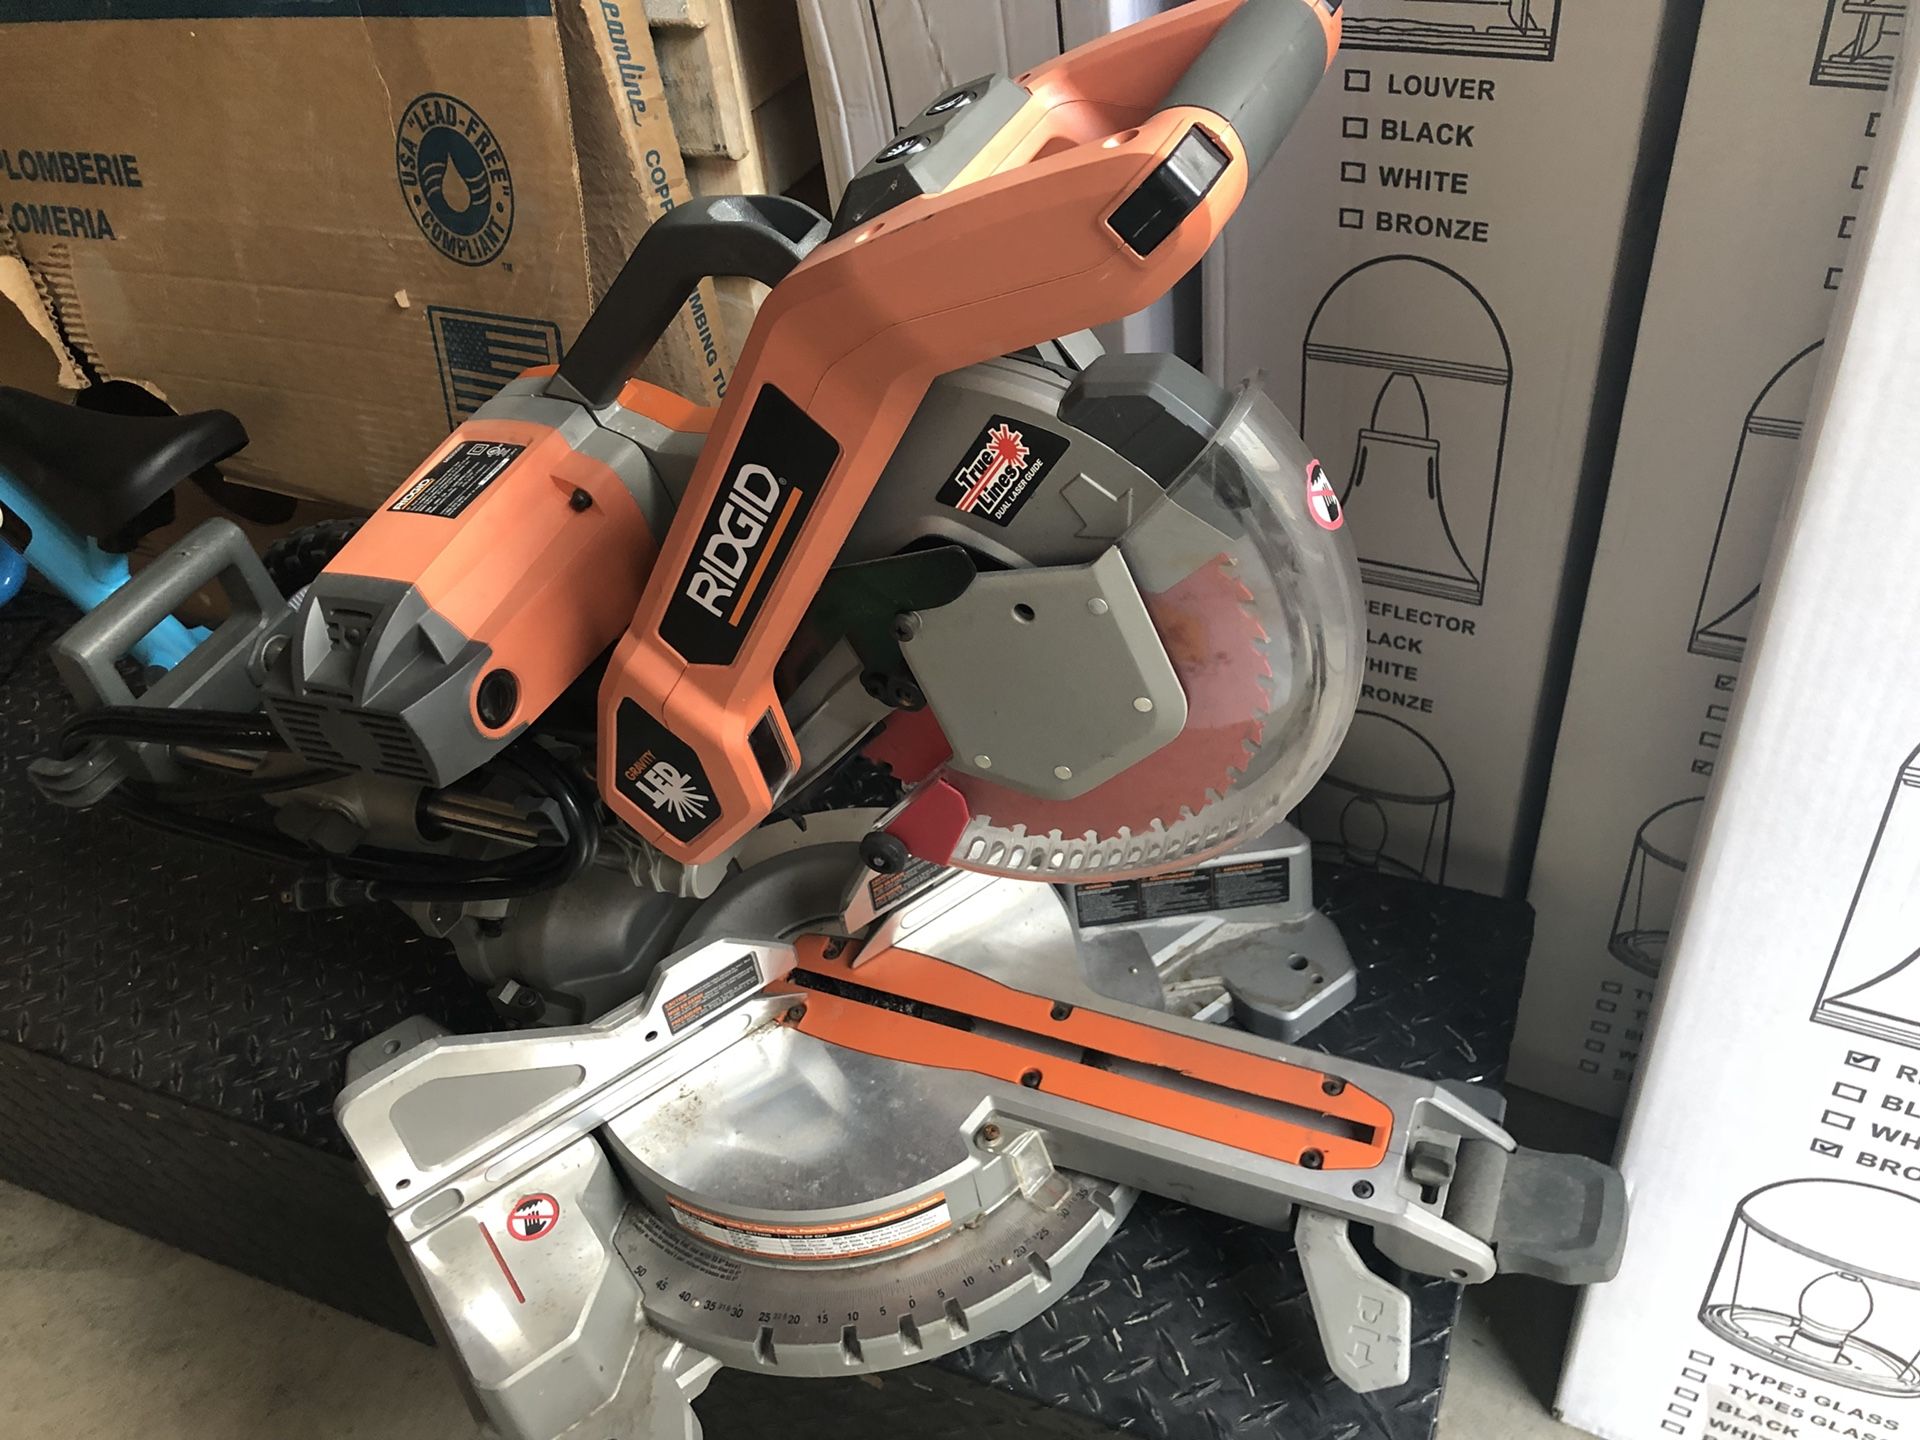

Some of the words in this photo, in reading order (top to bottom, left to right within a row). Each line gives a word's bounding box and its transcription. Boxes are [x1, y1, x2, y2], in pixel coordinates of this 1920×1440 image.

[1388, 73, 1496, 101] LOUVER
[1380, 118, 1475, 148] BLACK
[0, 148, 143, 188] LOMBERIE
[400, 136, 418, 187] USA
[1378, 165, 1469, 195] WHITE
[4, 202, 117, 240] OMERIA
[420, 215, 505, 260] COMPLIANT
[1375, 211, 1489, 243] BRONZE
[689, 286, 718, 368] MBING
[955, 448, 998, 490] True
[976, 464, 1020, 514] Lines
[994, 500, 1012, 520] DUAL
[1008, 479, 1028, 503] LASER
[1026, 458, 1044, 481] GUIDE
[686, 463, 780, 618] RIDGID
[1365, 600, 1476, 636] EFLECTOR
[1365, 656, 1418, 682] HITE
[624, 750, 656, 781] GRAVITY
[635, 761, 682, 809] LED
[1896, 1064, 1920, 1085] R
[634, 1265, 647, 1277] 50
[656, 1279, 668, 1290] 45
[679, 1291, 691, 1302] 40
[703, 1300, 717, 1311] 35
[730, 1308, 744, 1318] 30
[758, 1312, 771, 1322] 25
[788, 1314, 800, 1324] 20
[817, 1314, 828, 1324] 15
[847, 1311, 859, 1321] 10
[880, 1306, 887, 1316] 5
[909, 1300, 916, 1309] 0
[937, 1288, 945, 1298] 5
[962, 1276, 975, 1287] 10
[1728, 1383, 1804, 1418] TYPE5
[1810, 1415, 1888, 1440] GLAS
[1729, 1363, 1807, 1399] TYPE3
[1813, 1395, 1900, 1431] GLASS
[1716, 1401, 1800, 1438] BLACK
